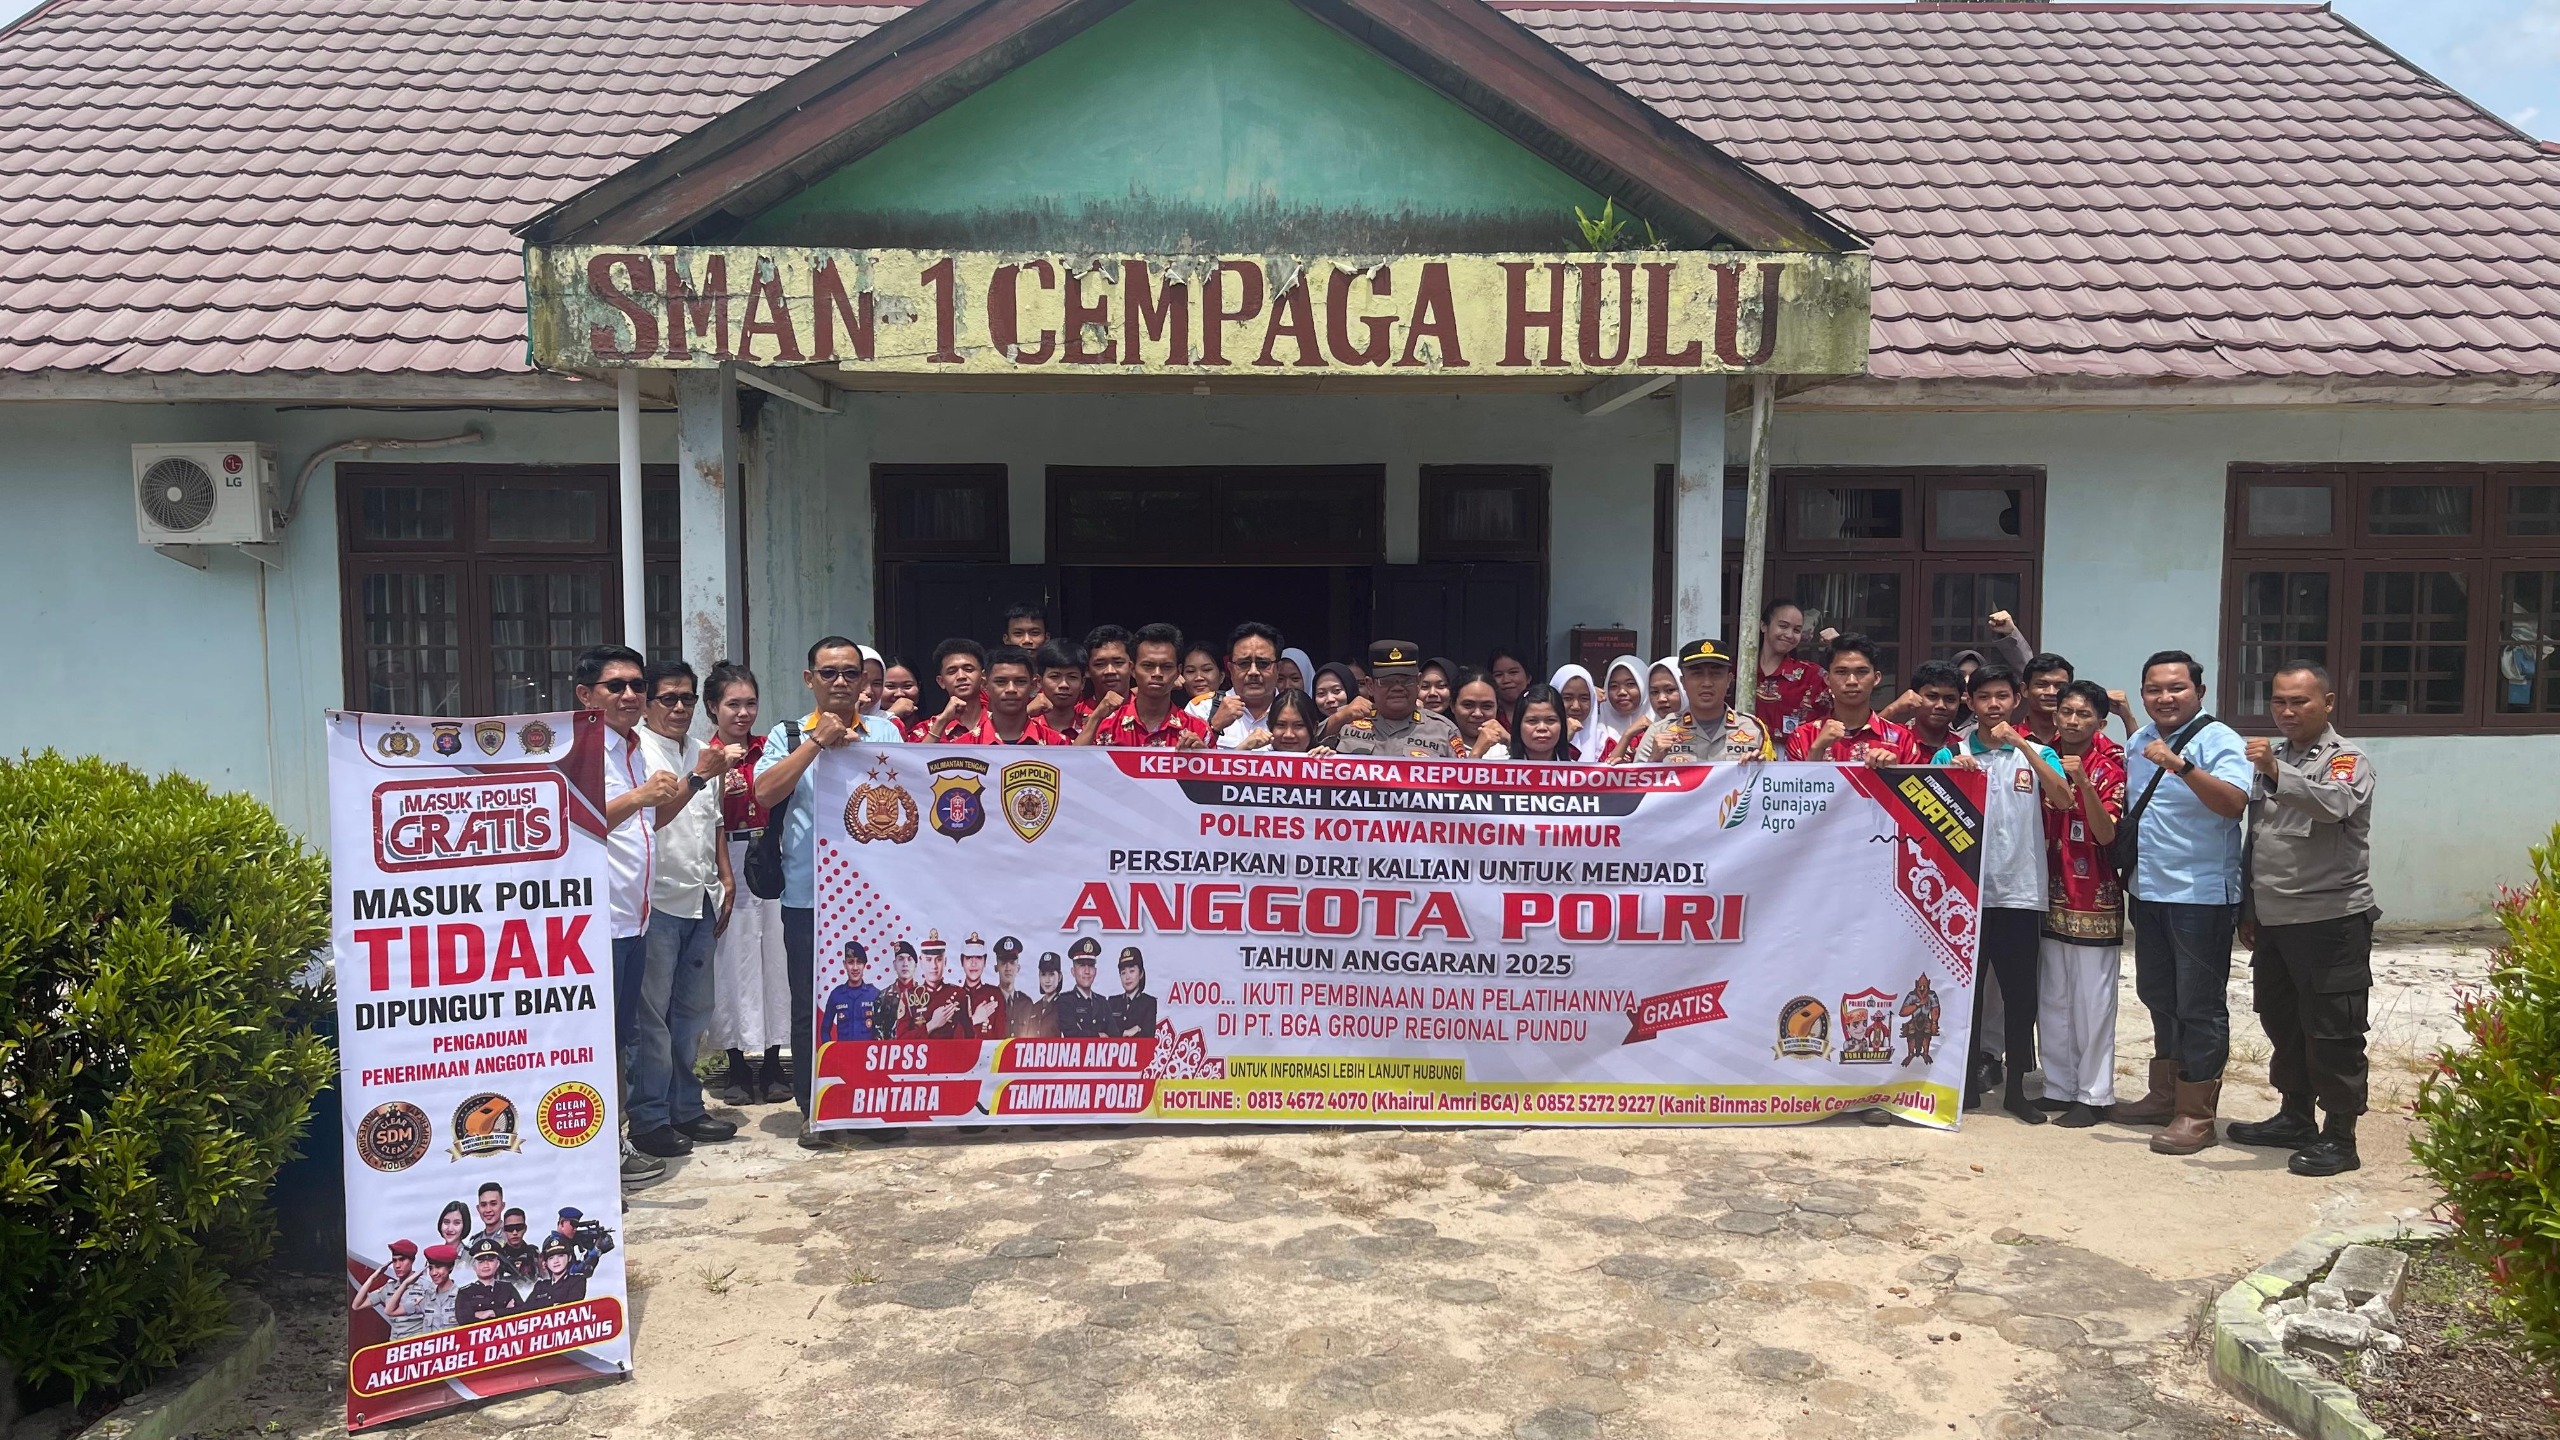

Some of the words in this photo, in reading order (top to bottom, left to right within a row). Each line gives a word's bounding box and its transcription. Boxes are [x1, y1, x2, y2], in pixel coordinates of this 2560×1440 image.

[987, 258, 1470, 368] CEMPAGA
[1496, 260, 1787, 368] HULU
[226, 477, 242, 487] LG
[1344, 728, 1376, 741] LULUK
[1407, 738, 1439, 750] POLRI
[930, 761, 963, 771] KALIMANTAN
[965, 761, 986, 772] TENGAH
[1009, 770, 1026, 781] SDM
[1028, 769, 1051, 781] POLRI
[1140, 756, 1293, 778] KEPOLISIAN
[1302, 760, 1401, 782] NEGARA
[1410, 766, 1533, 786] REPUBLIK
[1540, 769, 1681, 787] INDONESIA
[1762, 778, 1834, 793] Bumitama
[404, 792, 473, 813] MASUK
[1222, 786, 1321, 806] DAERAH
[1331, 789, 1493, 811] KALIMANTAN
[1500, 794, 1599, 812] TENGAH
[1762, 796, 1826, 815] Gunajaya
[1924, 775, 1954, 805] MASUK
[1950, 802, 1975, 829] POLISI
[1762, 816, 1795, 833] Agro
[1898, 775, 1975, 853] GRATIS
[390, 807, 551, 855] GRATIS
[1201, 813, 1305, 838] POLRES
[1315, 818, 1524, 845] KOTAWARINGIN
[1538, 825, 1621, 847] TIMUR
[1109, 851, 1285, 874] PERSIAPKAN
[1296, 856, 1359, 876] DIRI
[1368, 858, 1469, 880] KALIAN
[1479, 861, 1572, 882] UNTUK
[1582, 862, 1704, 882] MENJADI
[353, 884, 482, 920] MASUK
[496, 878, 592, 911] POLRI
[1061, 882, 1470, 938] ANGGOTA
[1502, 893, 1745, 940] POLRI
[354, 915, 595, 991] TIDAK
[1240, 948, 1334, 969] TAHUN
[1342, 950, 1495, 973] ANGGARAN
[1505, 954, 1572, 975] 2025
[356, 992, 504, 1030] DIPUNGUT
[515, 985, 596, 1016] BIAYA
[1168, 982, 1235, 1005] AYOO...
[1243, 983, 1293, 1006] IKUTI
[1302, 984, 1424, 1008] PEMBINAAN
[1432, 988, 1474, 1009] DAN
[1482, 989, 1638, 1013] PELATIHANNYA
[1643, 992, 1713, 1024] GRATIS
[1218, 1013, 1236, 1036] DI
[1245, 1014, 1273, 1036] PT.
[1281, 1014, 1321, 1037] BGA
[1329, 1016, 1398, 1038] GROUP
[1406, 1017, 1509, 1041] REGIONAL
[1516, 1019, 1586, 1041] PUNDU
[433, 1029, 528, 1053] PENGADUAN
[362, 1060, 469, 1086] PENERIMAAN
[475, 1052, 546, 1074] ANGGOTA
[550, 1047, 593, 1066] POLRI
[866, 1044, 928, 1070] SIPSS
[1015, 1043, 1079, 1067] TARUNA
[1083, 1043, 1138, 1067] AKPOL
[1231, 1062, 1267, 1078] UNTUK
[1271, 1062, 1331, 1078] INFORMASI
[1333, 1063, 1365, 1078] LEBIH
[1368, 1064, 1410, 1079] LANJUT
[1414, 1064, 1462, 1080] HUBUNGI
[556, 1100, 585, 1111] CLEAN
[852, 1085, 939, 1114] BINTARA
[1009, 1084, 1091, 1110] TAMTAMA
[1094, 1084, 1144, 1108] POLRI
[1164, 1092, 1233, 1109] HOTLINE
[1248, 1092, 1283, 1109] 0813
[1287, 1092, 1324, 1110] 4672
[1328, 1092, 1367, 1110] 4070
[1372, 1092, 1434, 1112] (Khairul
[1438, 1092, 1477, 1111] Amri
[1480, 1093, 1519, 1113] BGA)
[1524, 1094, 1533, 1111] &
[1537, 1094, 1575, 1112] 0852
[1579, 1095, 1616, 1112] 5272
[1619, 1095, 1654, 1113] 9227
[1659, 1094, 1706, 1115] (Kanit
[1711, 1095, 1766, 1114] Binmas
[1771, 1094, 1820, 1113] Polsek
[1892, 1091, 1935, 1114] Hulu)
[377, 1127, 412, 1144] SDM
[381, 1118, 407, 1129] CLEAR
[557, 1118, 586, 1130] CLEAR
[381, 1143, 408, 1154] CLEAN
[386, 1336, 460, 1364] BERSIH,
[468, 1305, 596, 1346] TRANSPARAN,
[365, 1354, 478, 1390] AKUNTABEL
[484, 1342, 524, 1363] DAN
[529, 1320, 612, 1353] HUMANIS
